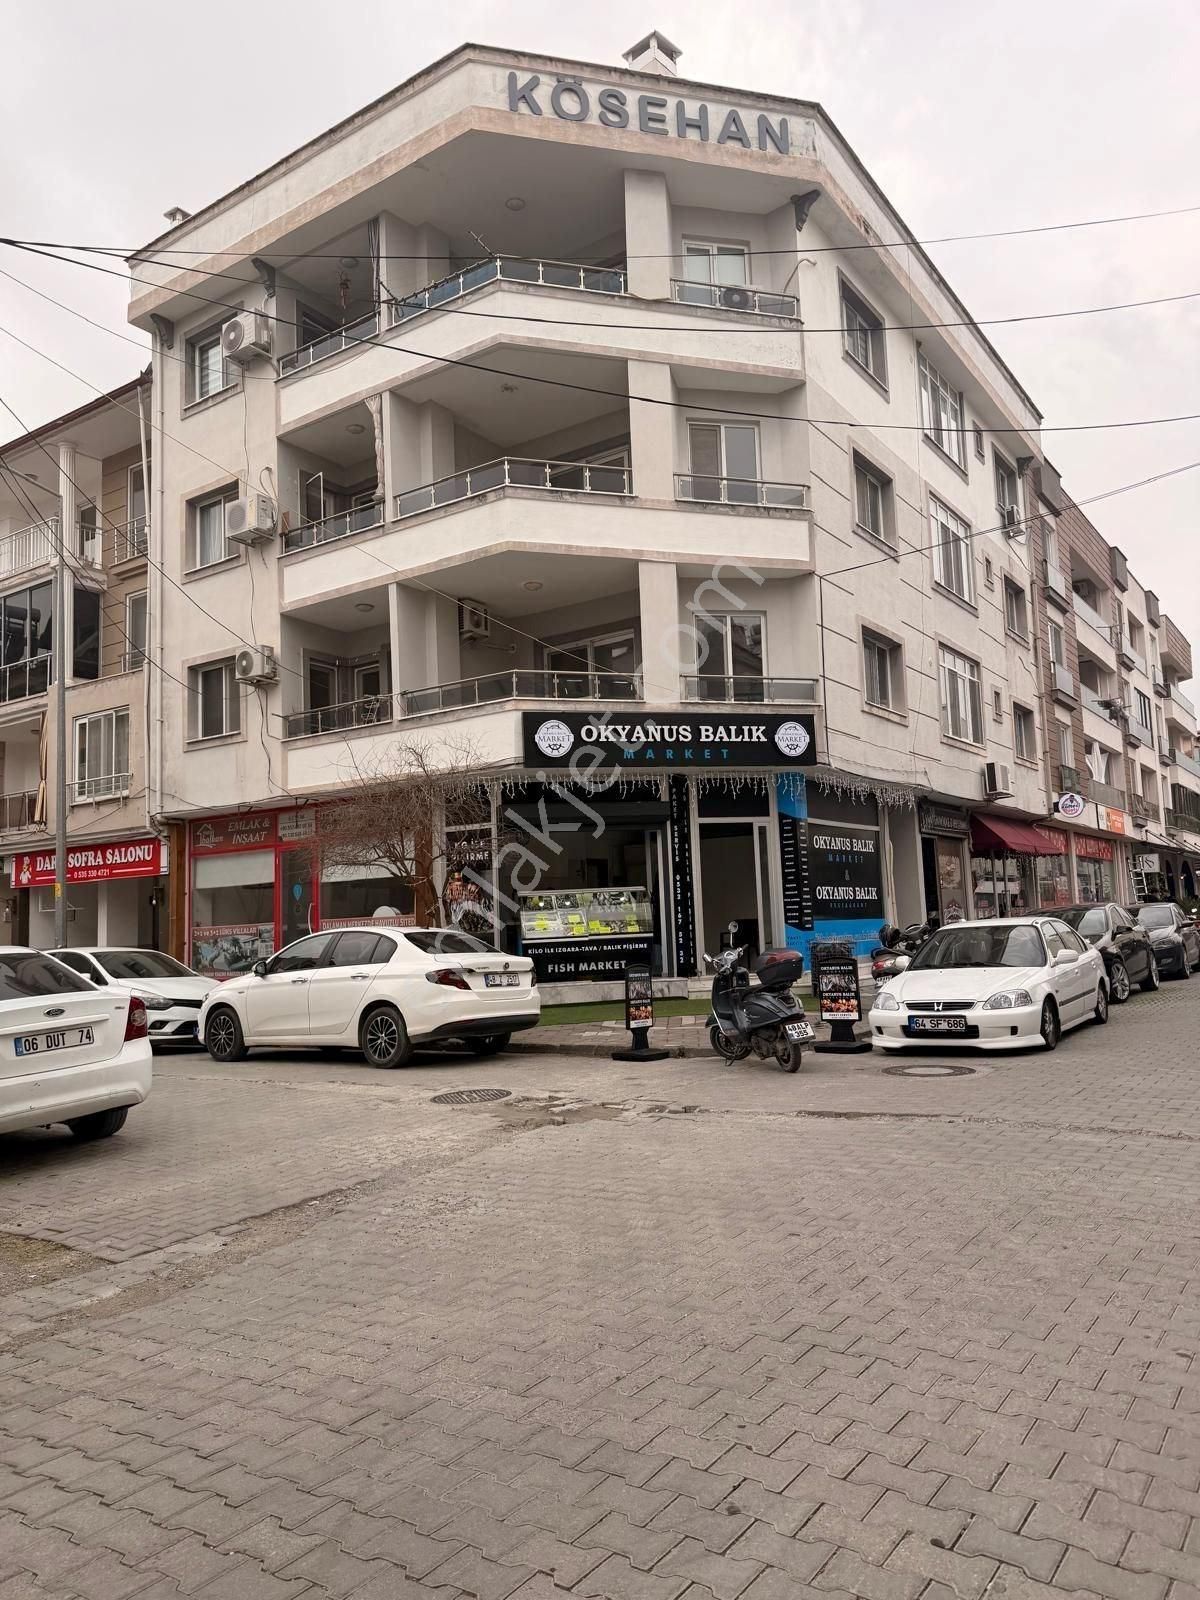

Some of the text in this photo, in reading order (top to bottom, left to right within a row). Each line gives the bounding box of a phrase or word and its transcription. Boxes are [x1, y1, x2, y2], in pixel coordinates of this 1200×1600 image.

[507, 71, 791, 155] KÖSEHAN
[580, 725, 768, 742] OKYANUS BALIK
[623, 748, 729, 760] MARKET
[228, 818, 262, 832] EMLAK
[813, 835, 875, 852] OKYANUS BALIK
[67, 851, 103, 868] SOFRA
[105, 844, 154, 865] SALONU
[816, 886, 878, 900] OKYANUS BALIK
[555, 945, 597, 953] IZGARA-TAVA
[547, 960, 626, 973] FISH MARKET
[915, 1019, 965, 1029] 64 SF 686
[23, 1037, 38, 1052] 06
[46, 1032, 66, 1049] DUT
[78, 1029, 92, 1043] 74
[795, 1029, 809, 1038] 355
